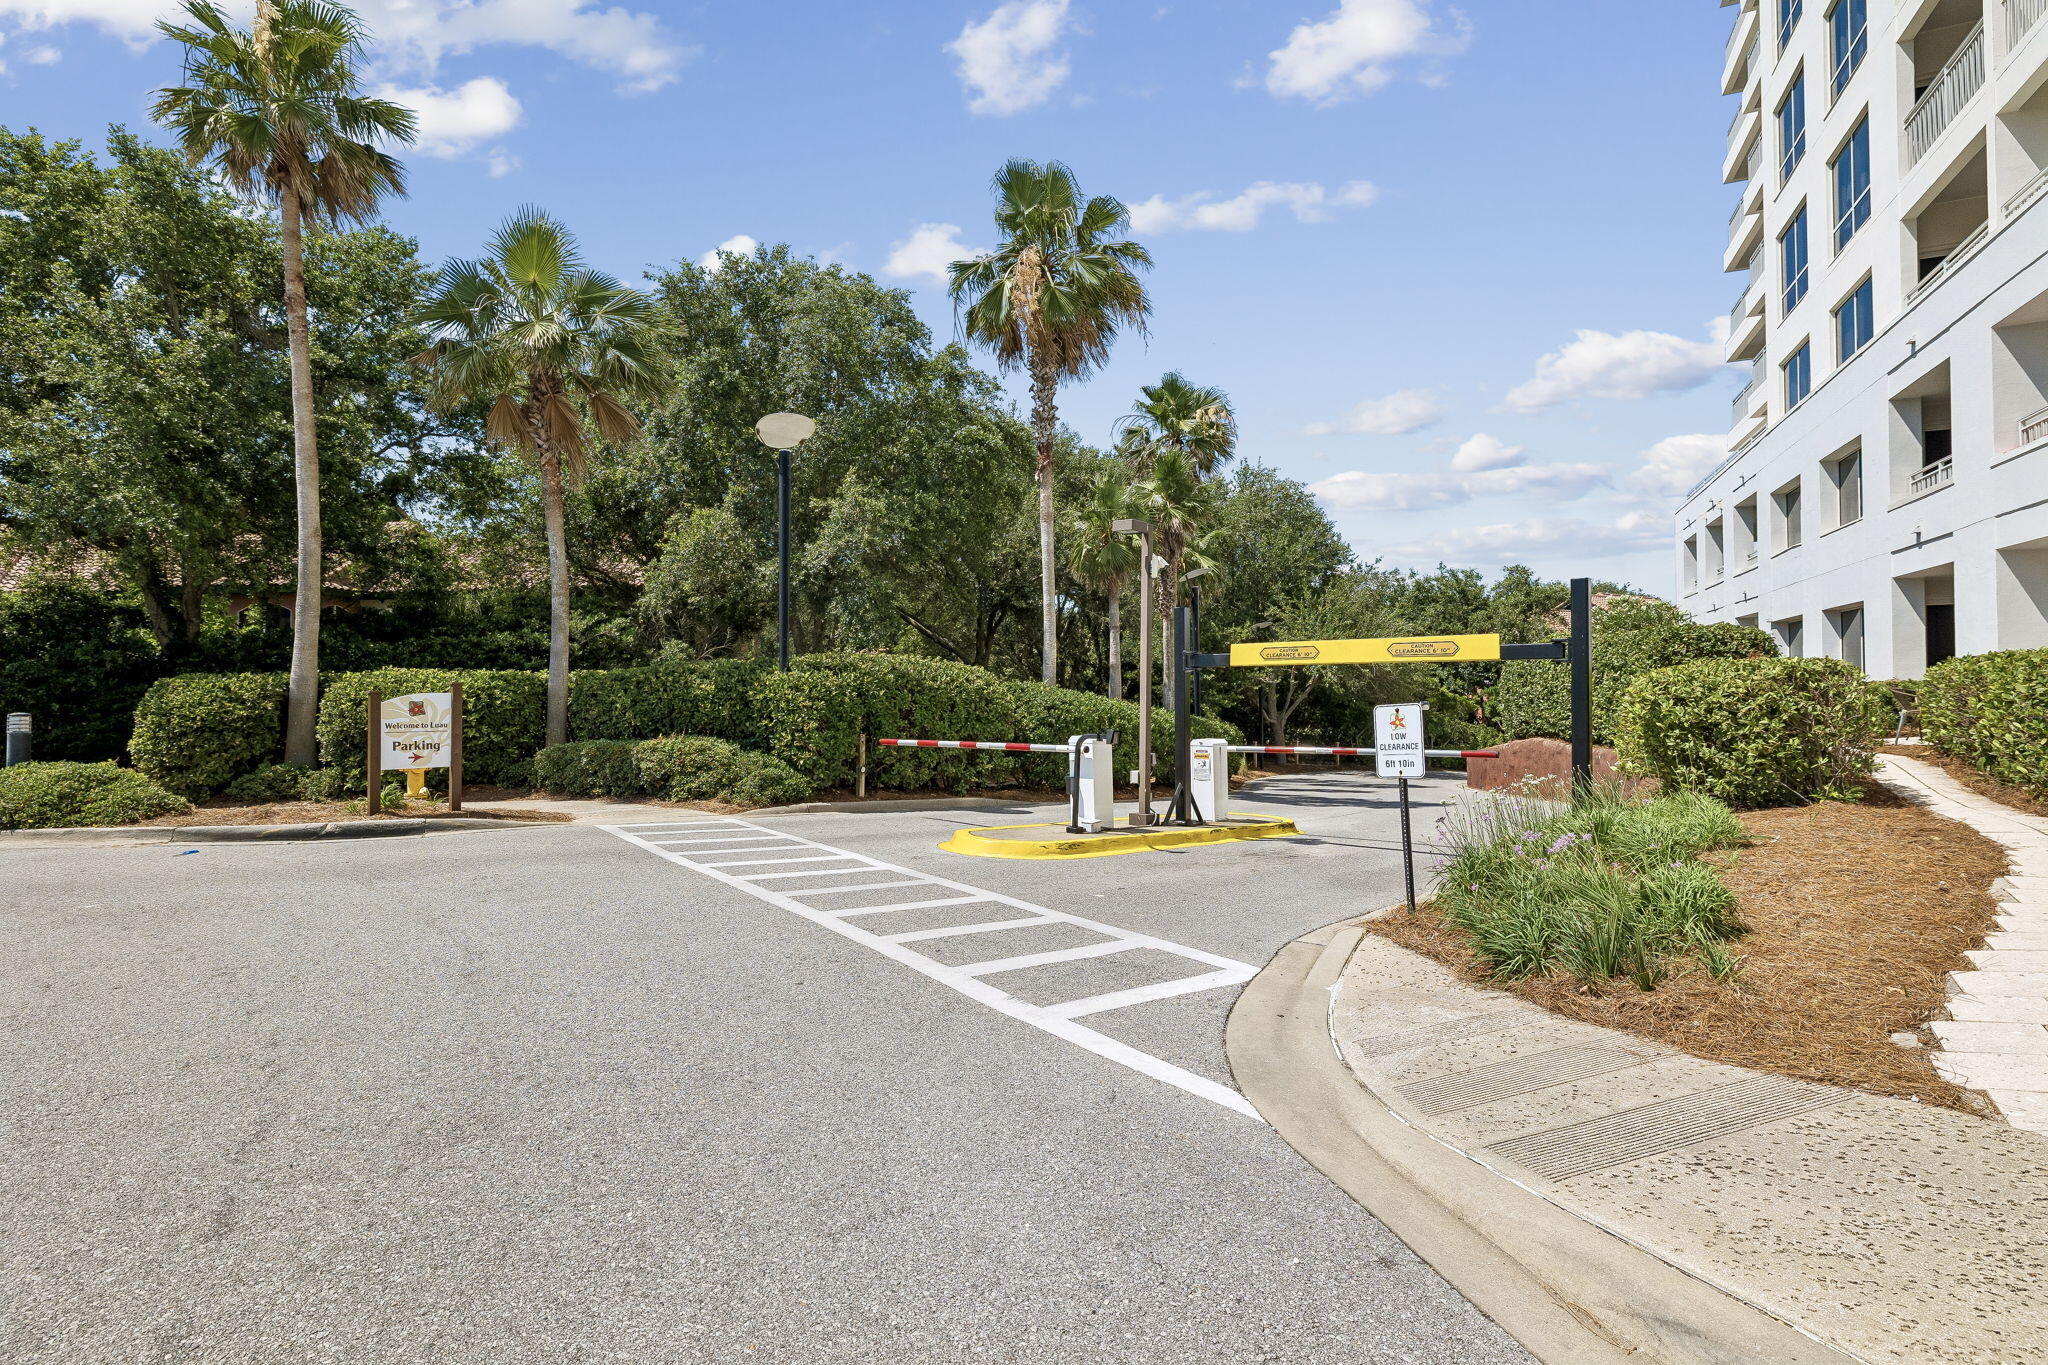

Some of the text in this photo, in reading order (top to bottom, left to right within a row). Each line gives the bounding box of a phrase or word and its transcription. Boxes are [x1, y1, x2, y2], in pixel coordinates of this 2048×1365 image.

[384, 722, 419, 730] Welcome
[430, 721, 448, 729] Luau
[1390, 732, 1407, 740] LOW
[392, 740, 441, 752] Parking
[1380, 743, 1419, 751] CLEARANCE
[1385, 759, 1415, 768] 6ft 10in
